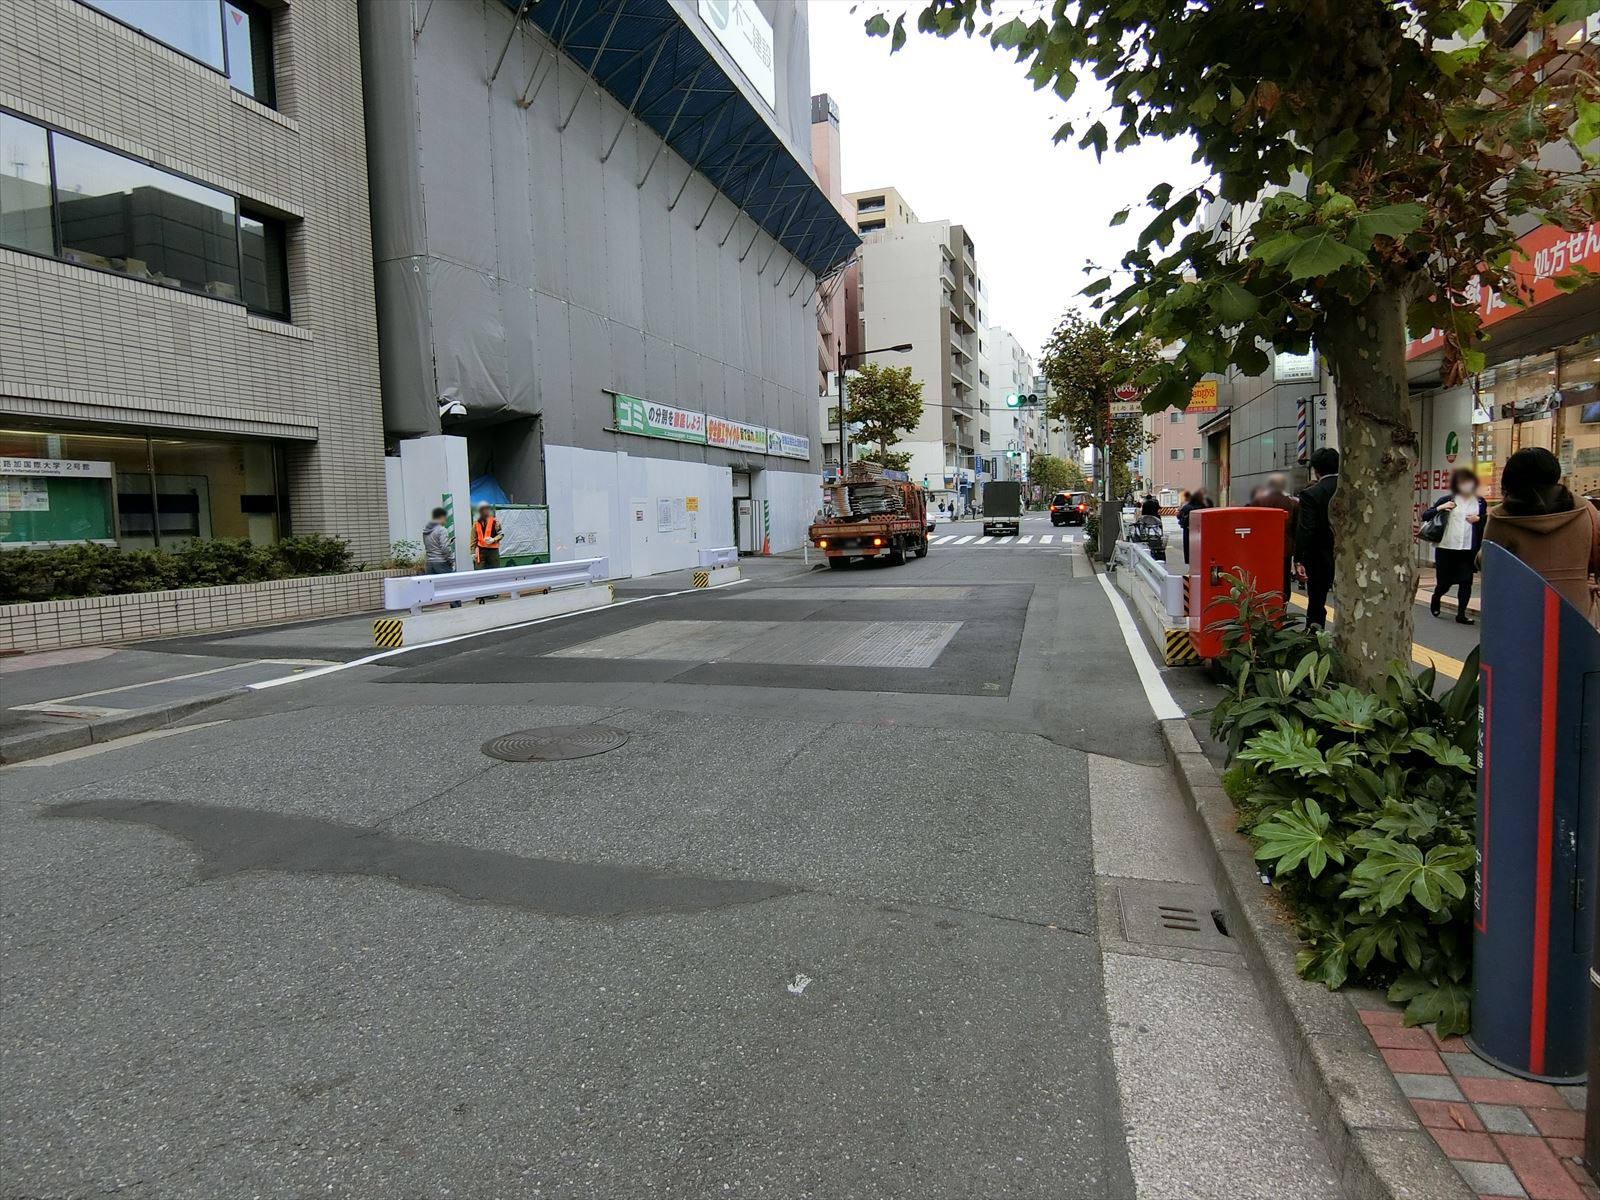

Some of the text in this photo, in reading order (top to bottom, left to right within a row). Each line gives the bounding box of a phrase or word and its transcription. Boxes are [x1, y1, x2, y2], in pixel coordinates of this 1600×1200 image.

[1192, 387, 1215, 399] enny's
[620, 402, 644, 430] ゴミ
[0, 460, 90, 471] 路加国際大学 2号館
